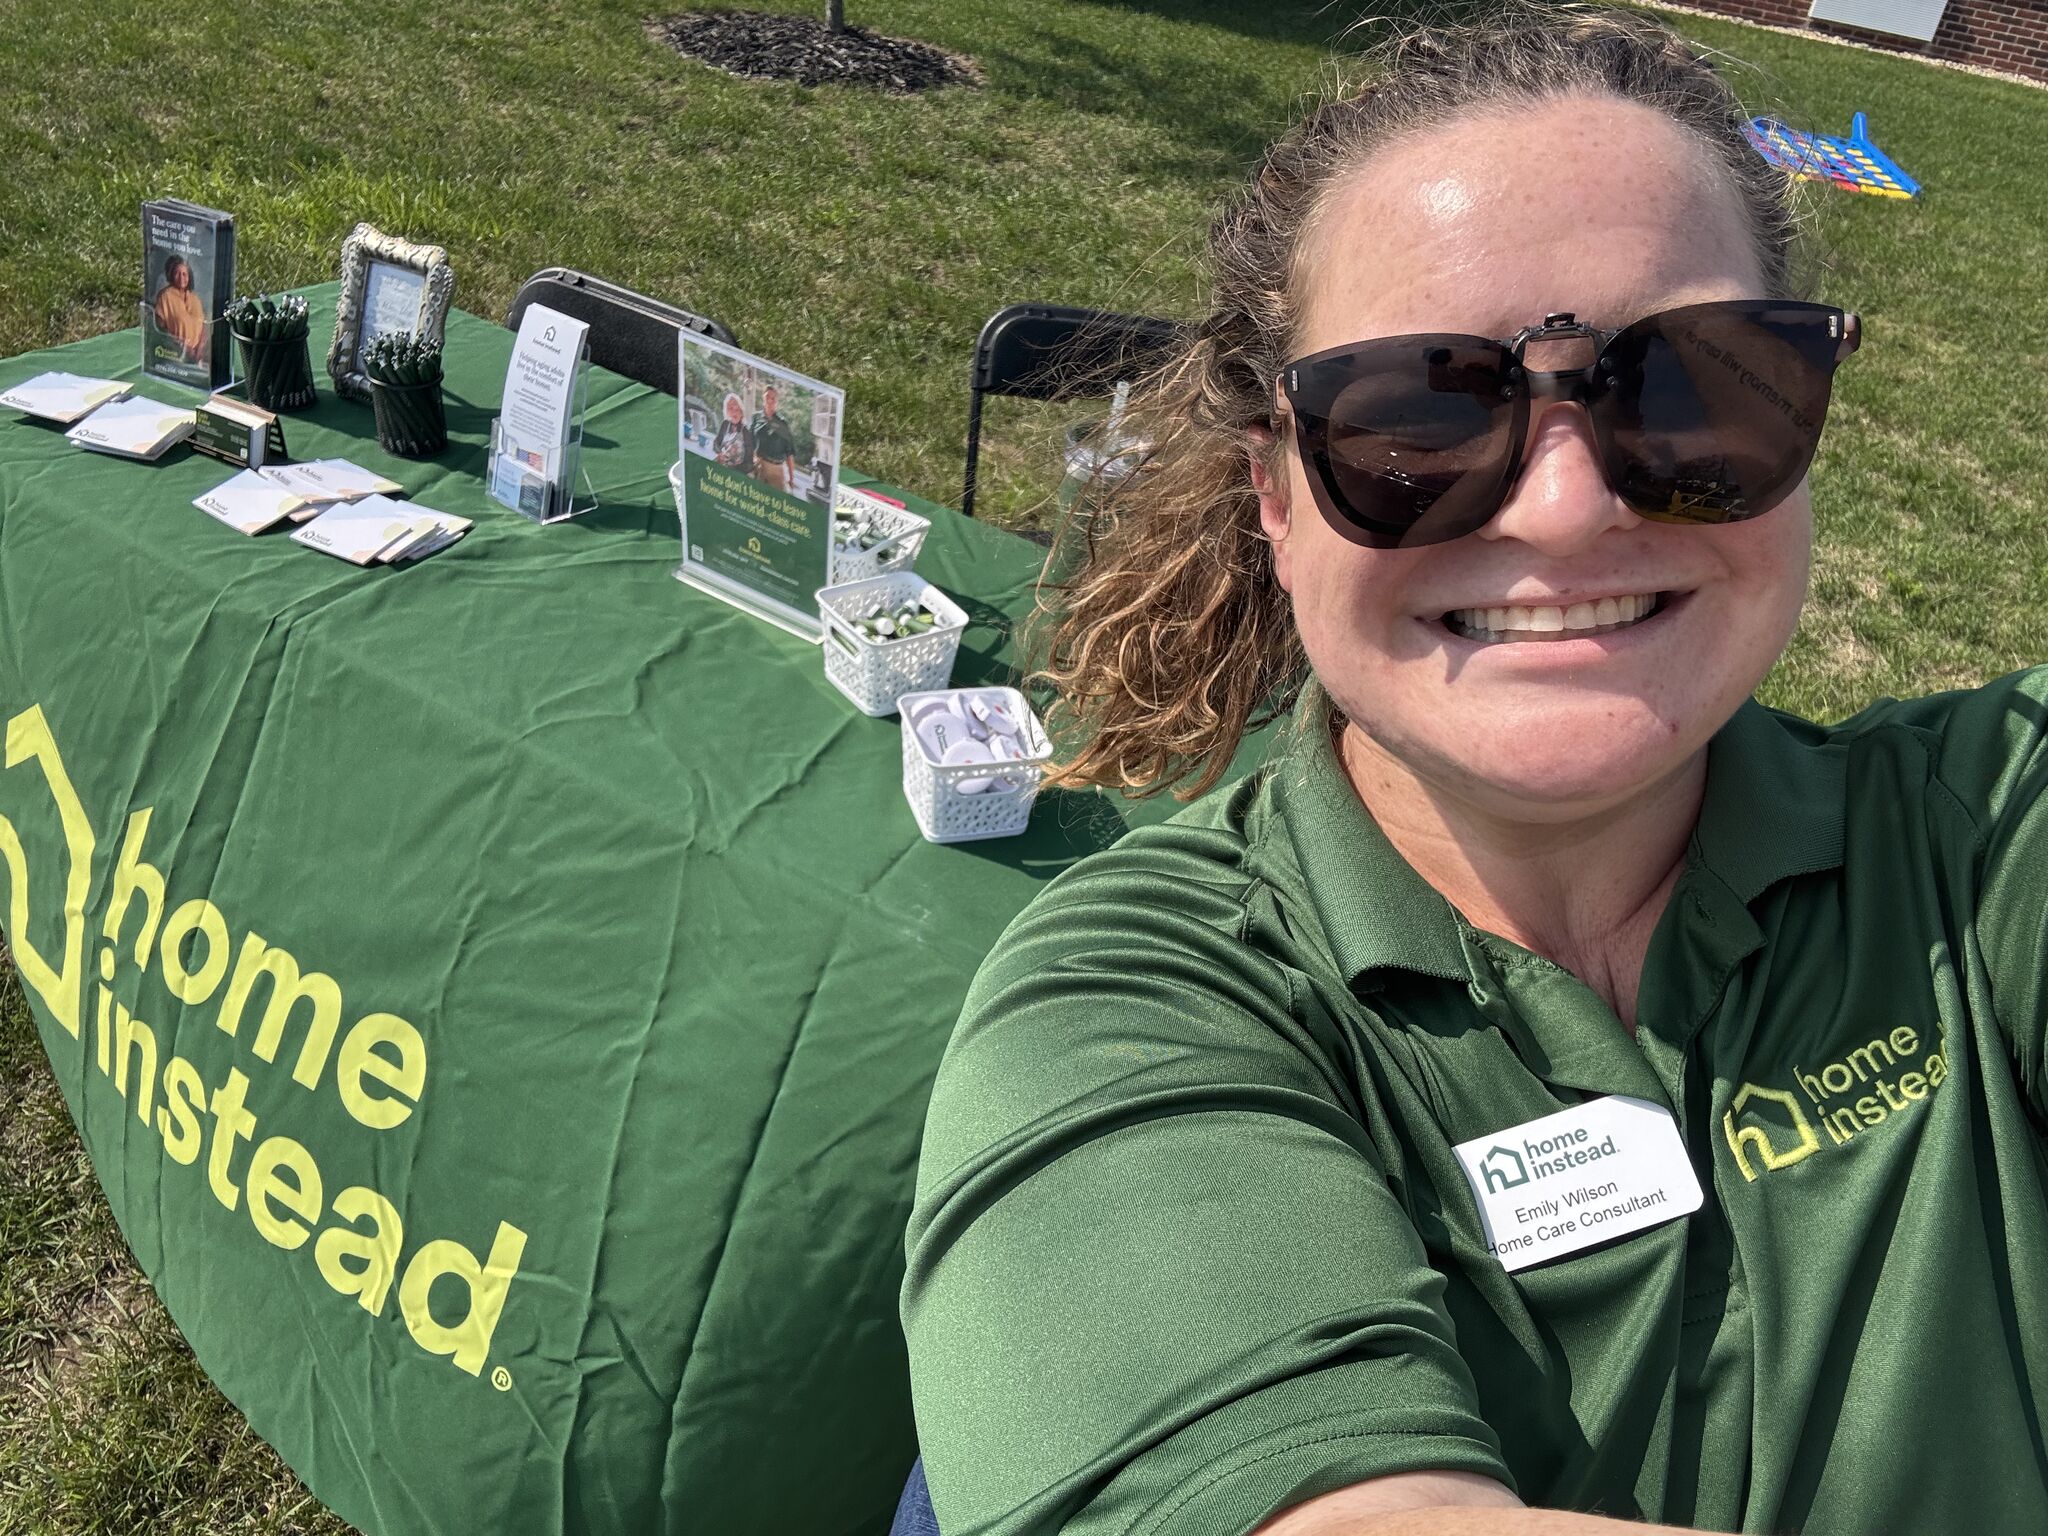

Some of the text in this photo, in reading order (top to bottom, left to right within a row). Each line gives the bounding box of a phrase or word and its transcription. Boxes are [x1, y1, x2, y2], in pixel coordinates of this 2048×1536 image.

[152, 215, 165, 228] The
[182, 223, 196, 235] you
[170, 229, 178, 240] in
[178, 232, 190, 244] the
[700, 478, 725, 501] home
[724, 488, 738, 507] for
[705, 465, 724, 485] You
[748, 485, 771, 506] have
[771, 497, 782, 510] to
[782, 498, 807, 521] leave
[101, 806, 428, 1130] home
[1793, 1025, 1919, 1104] home
[1523, 1127, 1589, 1160] home
[1515, 1180, 1619, 1224] Emily Wilson
[1537, 1220, 1577, 1242] Care
[1579, 1188, 1667, 1228] Consultant
